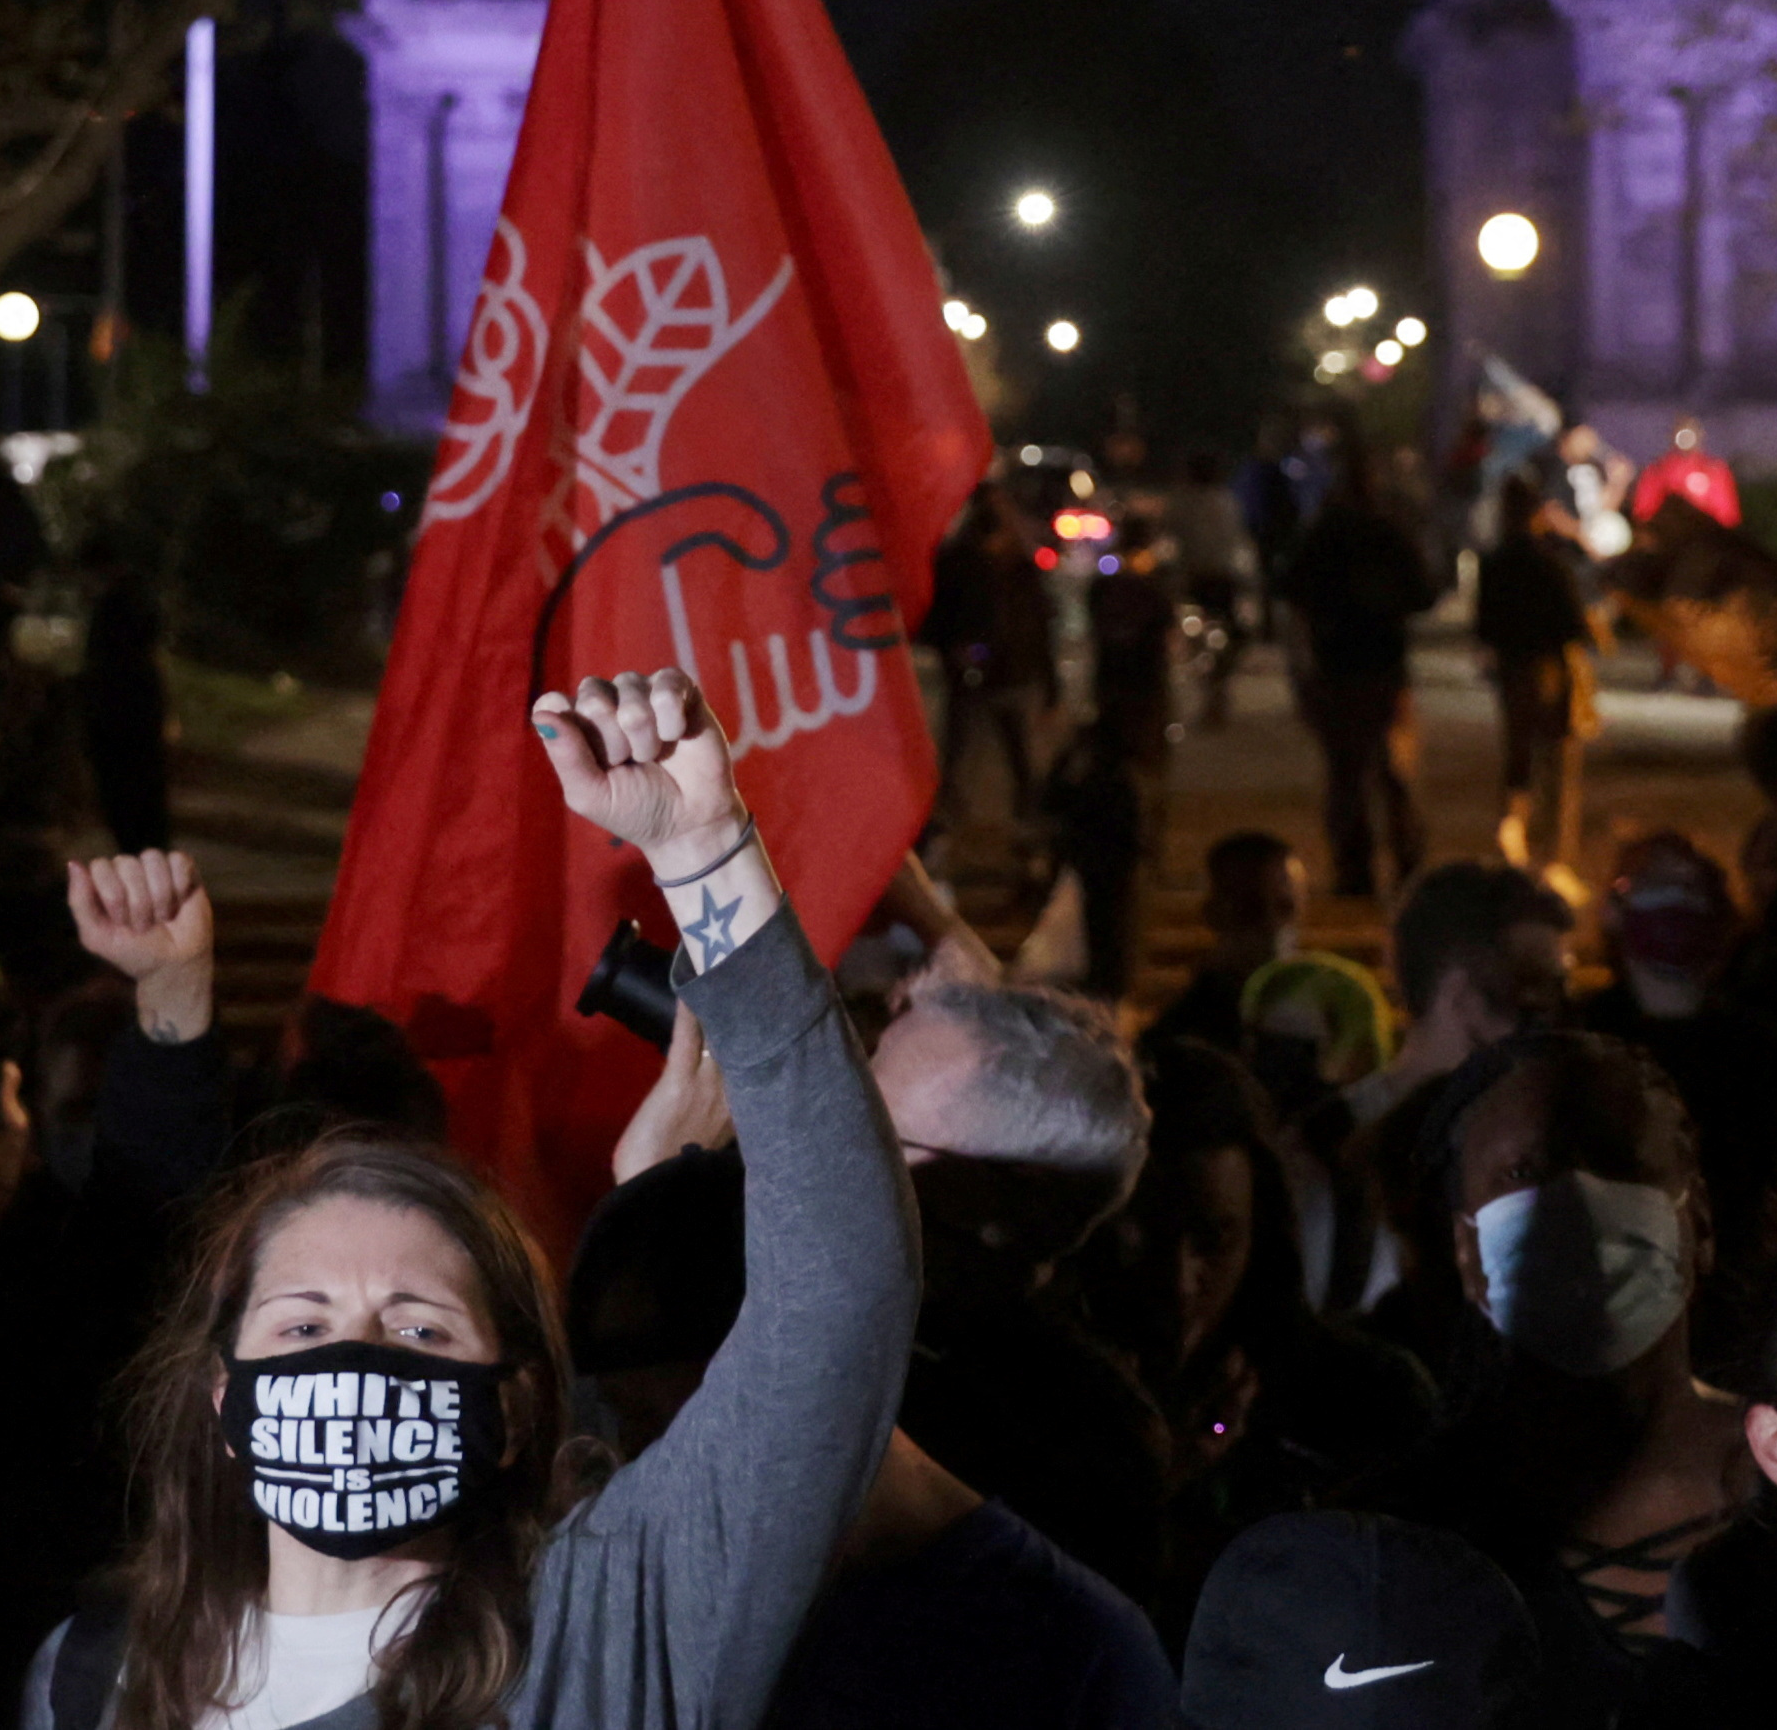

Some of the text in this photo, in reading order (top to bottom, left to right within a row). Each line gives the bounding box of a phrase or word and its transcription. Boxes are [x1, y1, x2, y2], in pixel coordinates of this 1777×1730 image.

[255, 1372, 461, 1419] WHITE
[250, 1418, 463, 1465] SILENCE
[332, 1468, 371, 1491] IS
[253, 1477, 460, 1532] VIOLENCE
